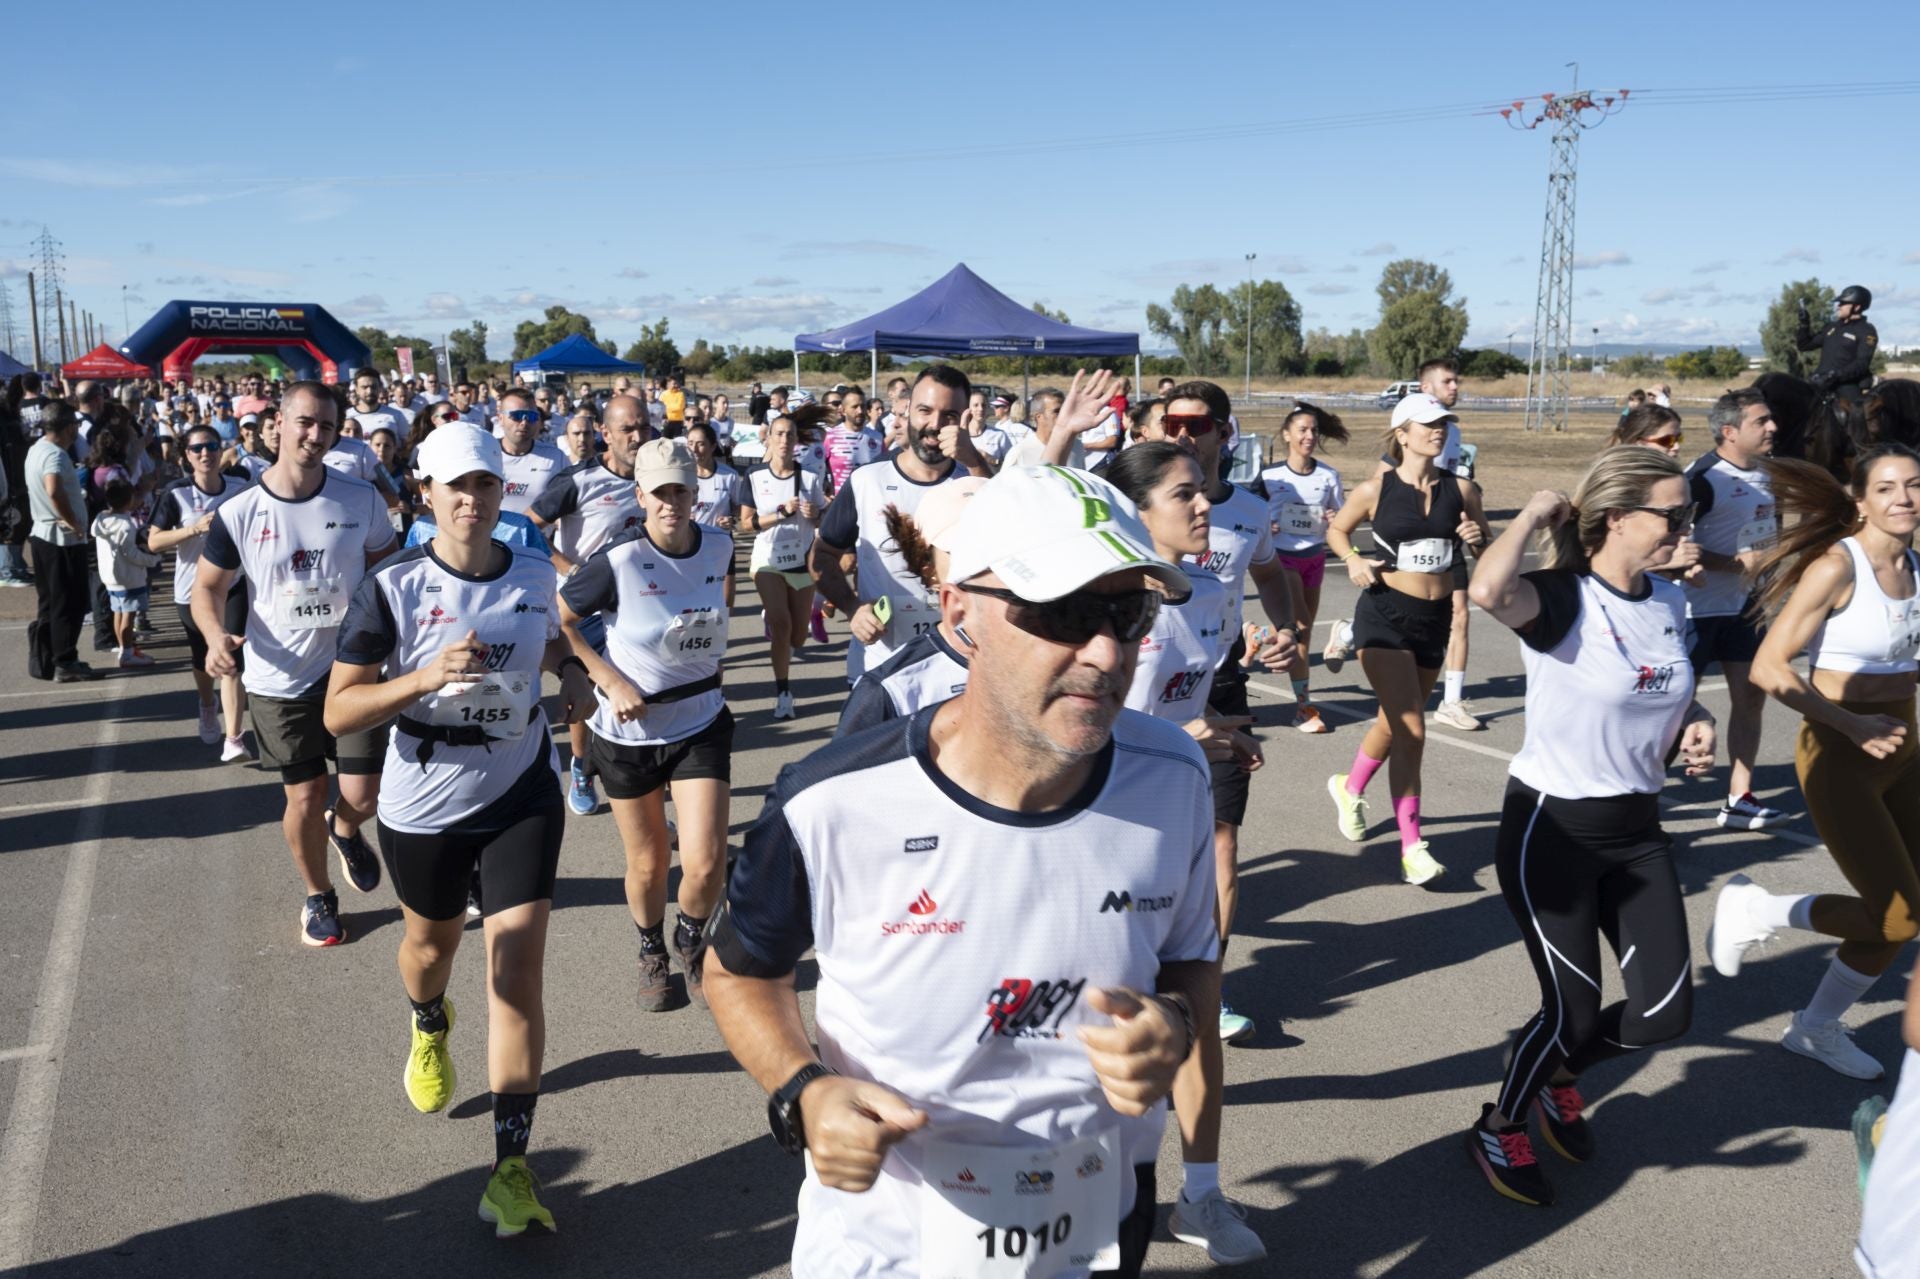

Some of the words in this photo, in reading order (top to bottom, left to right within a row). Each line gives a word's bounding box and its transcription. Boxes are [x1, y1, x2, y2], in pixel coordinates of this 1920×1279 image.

[190, 307, 281, 319] POLICIA
[191, 319, 305, 331] NACIONAL
[1412, 554, 1441, 566] 1551
[295, 603, 331, 617] 1415
[417, 616, 458, 626] Santander
[679, 637, 712, 651] 1456
[460, 706, 511, 723] 1455
[881, 919, 966, 937] Santander
[977, 1213, 1072, 1258] 1010
